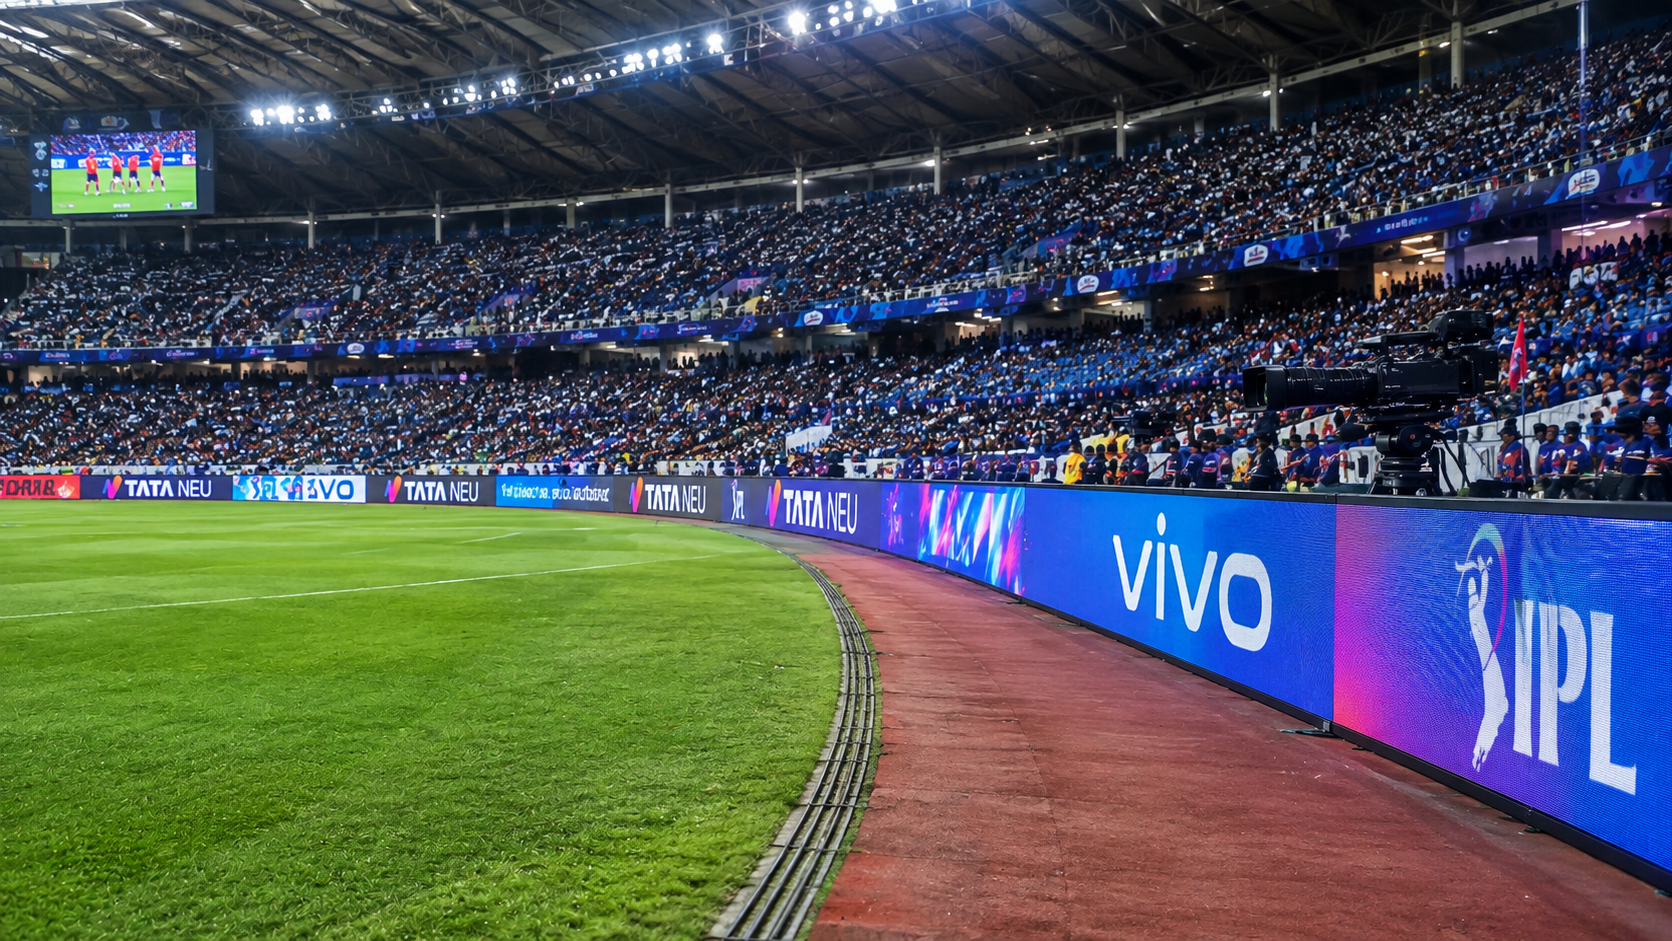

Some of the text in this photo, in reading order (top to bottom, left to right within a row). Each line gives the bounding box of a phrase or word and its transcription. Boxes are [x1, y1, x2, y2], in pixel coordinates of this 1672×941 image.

[125, 479, 212, 498] TATA NEU
[403, 481, 447, 501] TATA
[450, 481, 479, 503] NEU
[644, 484, 681, 512] TATA
[682, 485, 707, 514] NEU
[783, 488, 824, 530] TATA
[826, 491, 858, 535] NEU
[1112, 511, 1273, 652] vivo
[1512, 597, 1637, 796] IPL
